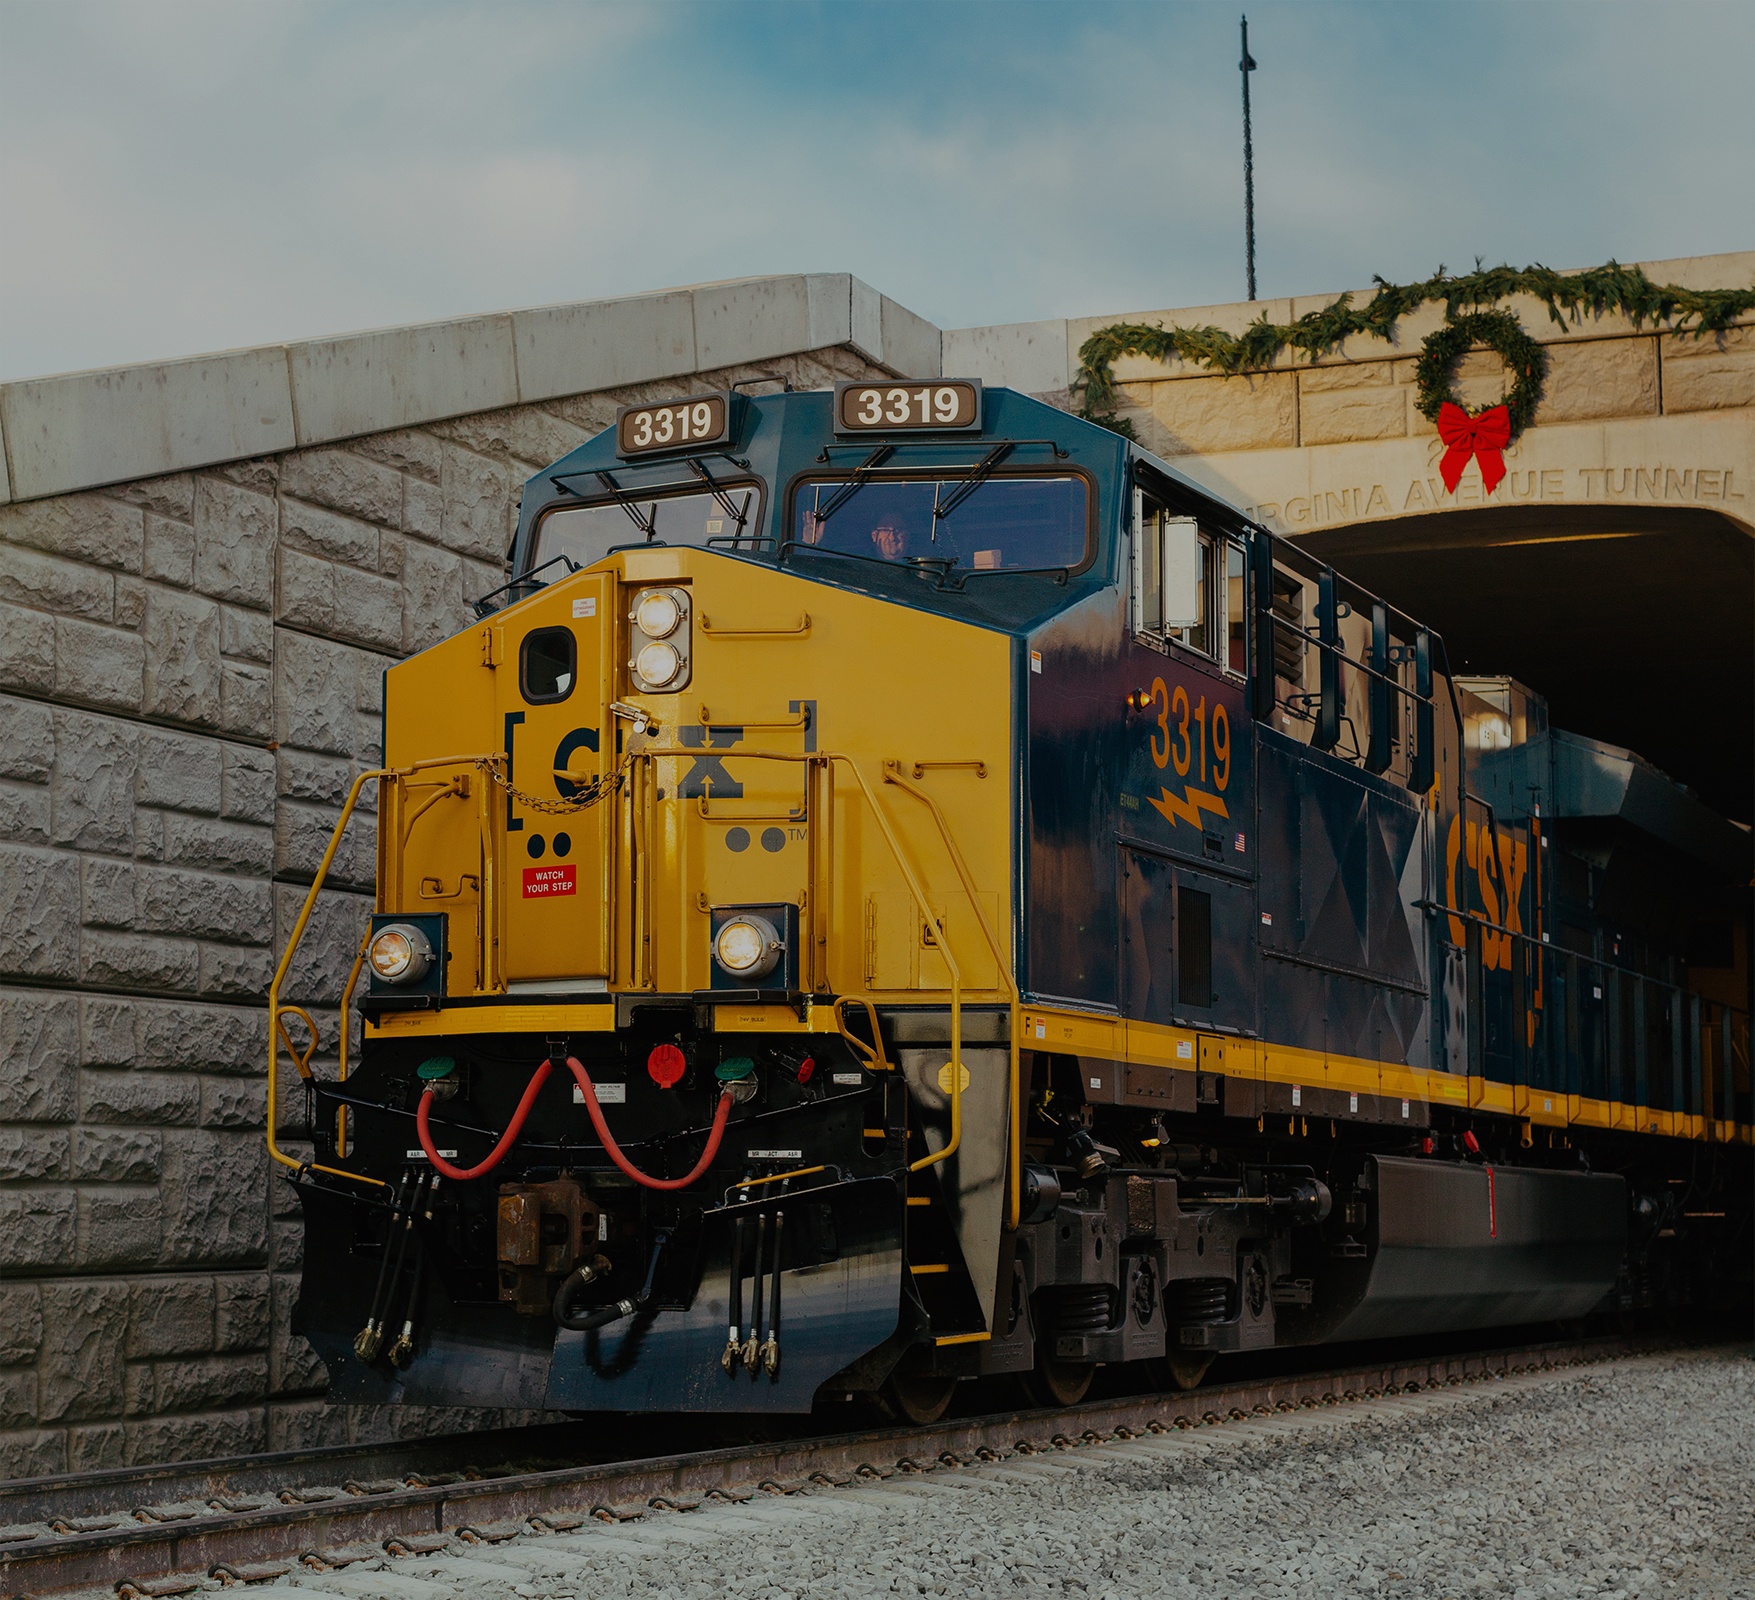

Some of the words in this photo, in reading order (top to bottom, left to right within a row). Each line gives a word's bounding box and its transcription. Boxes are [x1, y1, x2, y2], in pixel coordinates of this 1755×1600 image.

[633, 402, 712, 447] 3319
[857, 387, 960, 425] 3319
[1242, 484, 1393, 530] RGINIA
[1578, 467, 1745, 500] TUNNEL
[1149, 676, 1231, 791] 3319
[526, 883, 549, 894] YOUR
[552, 881, 573, 892] STEP
[535, 870, 564, 881] WATCH
[1446, 813, 1528, 972] CSX
[1025, 1016, 1031, 1036] F
